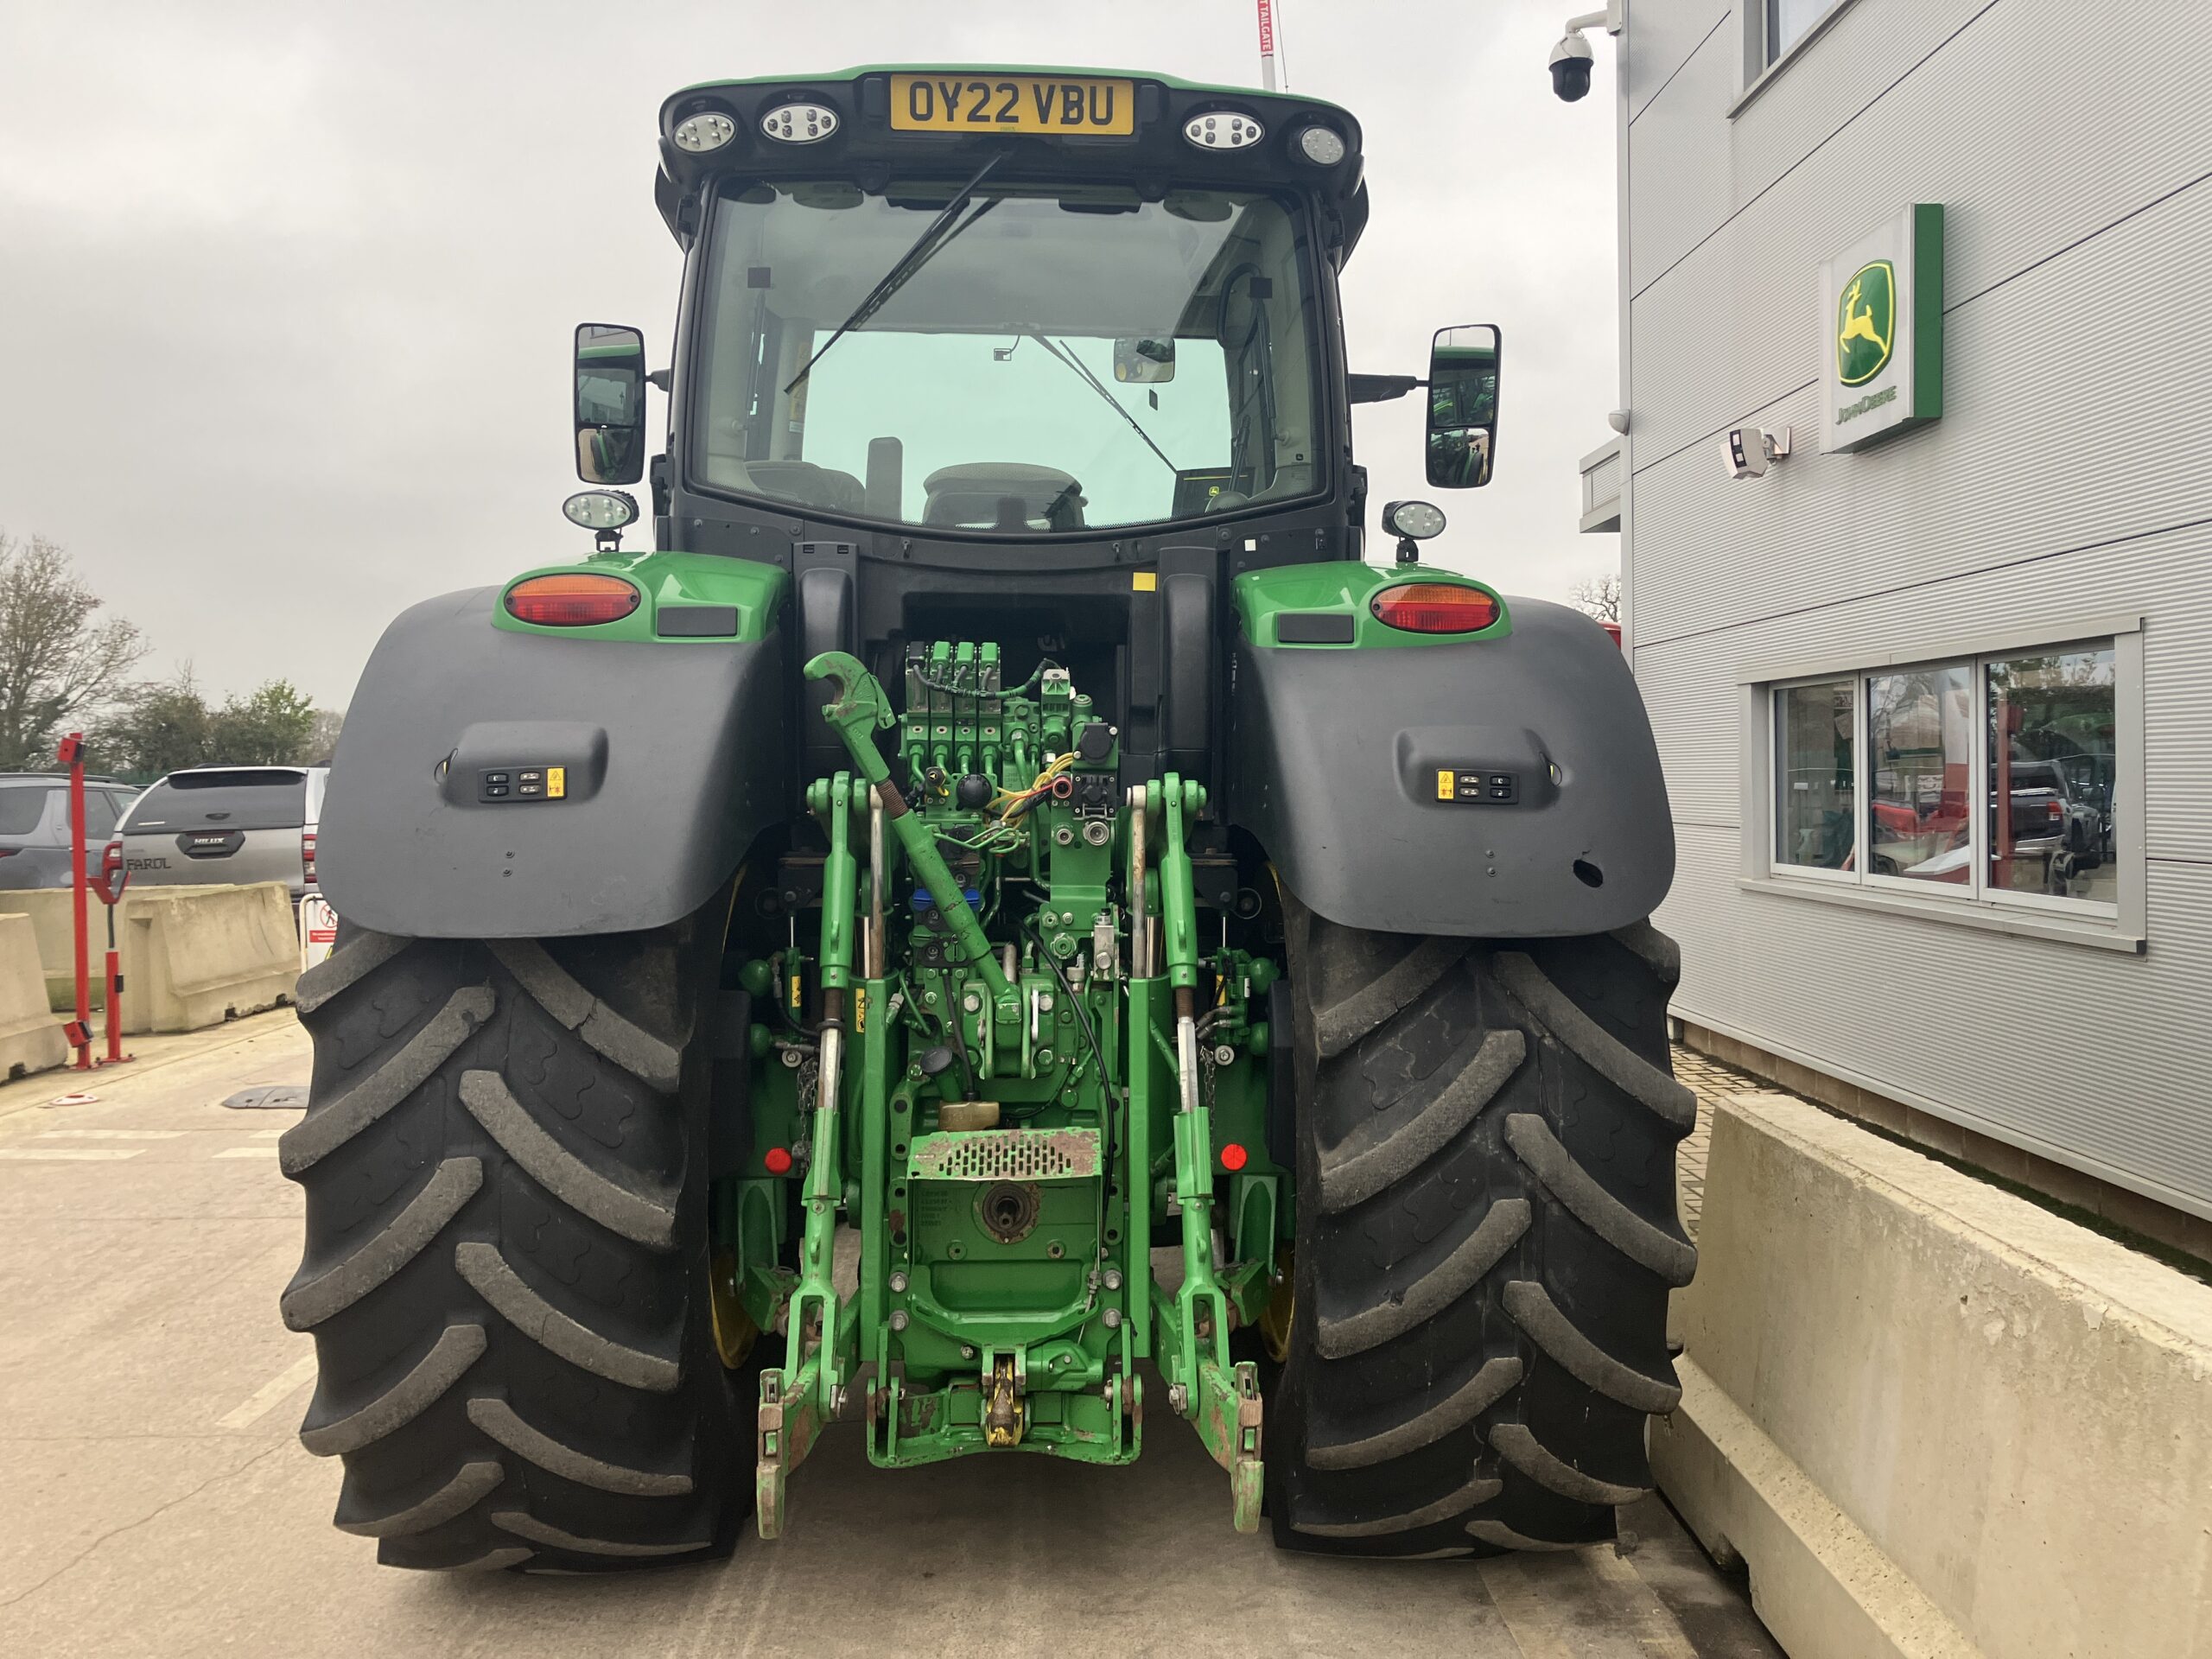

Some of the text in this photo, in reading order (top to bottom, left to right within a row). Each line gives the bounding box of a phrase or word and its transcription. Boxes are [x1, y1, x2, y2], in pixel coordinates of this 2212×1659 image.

[1260, 6, 1272, 51] TAILGATE
[909, 81, 1114, 125] OY22 VBU
[126, 858, 172, 871] FAROL
